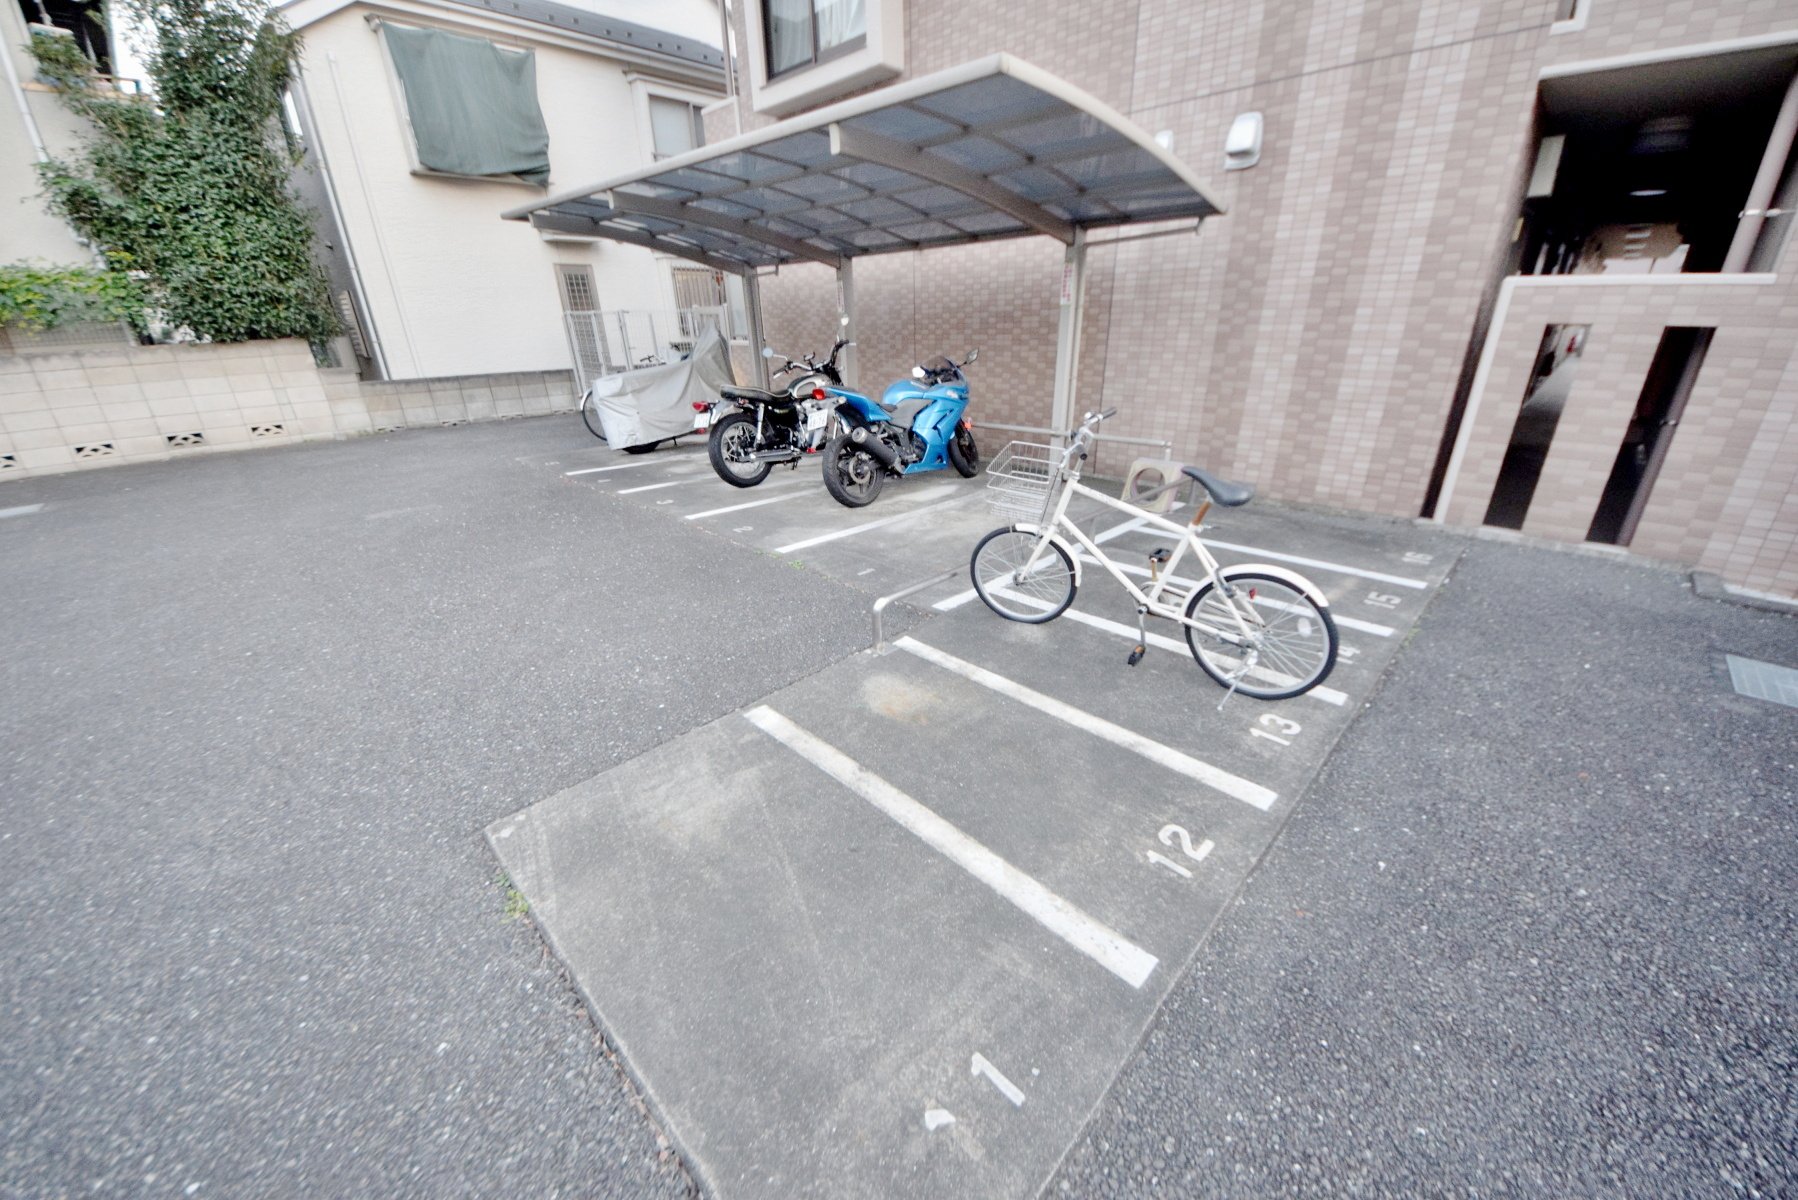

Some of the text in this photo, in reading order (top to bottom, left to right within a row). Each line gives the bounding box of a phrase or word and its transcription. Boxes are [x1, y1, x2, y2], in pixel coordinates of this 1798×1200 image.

[1364, 591, 1402, 609] 15
[1250, 713, 1302, 746] 13
[1147, 824, 1215, 878] 12
